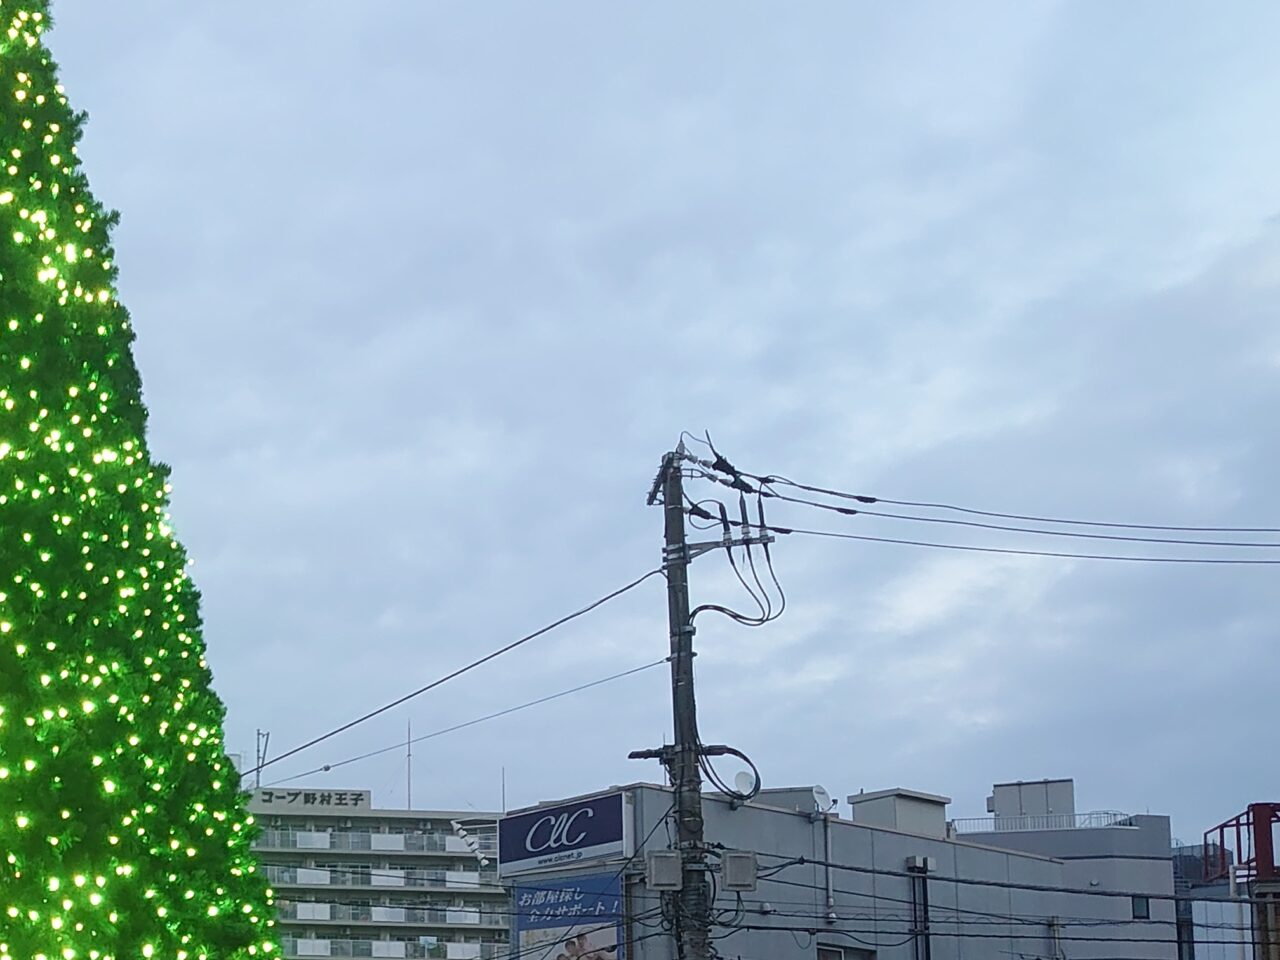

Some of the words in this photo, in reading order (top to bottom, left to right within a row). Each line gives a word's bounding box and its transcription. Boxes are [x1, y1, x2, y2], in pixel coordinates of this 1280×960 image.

[261, 790, 365, 806] コープ野村王子
[518, 887, 585, 907] お部屋探し
